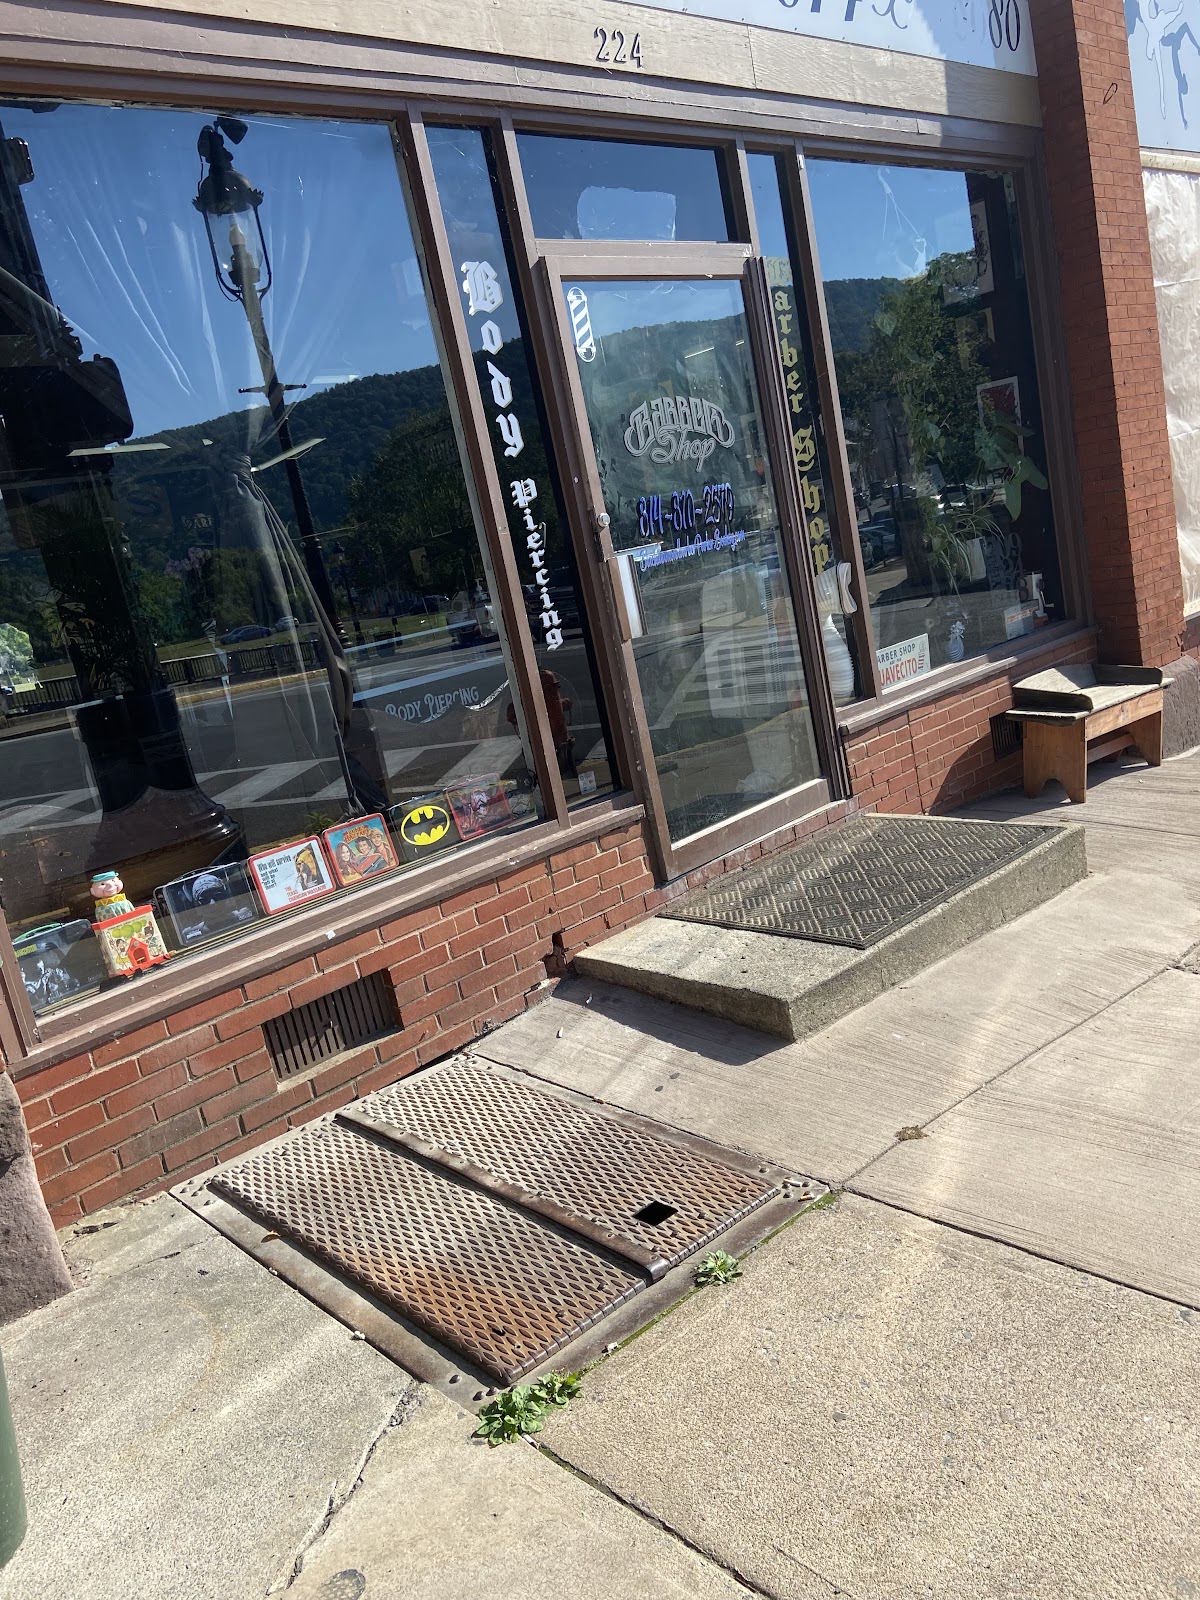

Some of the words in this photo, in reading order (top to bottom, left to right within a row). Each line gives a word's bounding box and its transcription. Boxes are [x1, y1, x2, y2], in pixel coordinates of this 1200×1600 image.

[593, 26, 642, 68] 224
[766, 256, 803, 414] Barber
[793, 424, 829, 576] Shop
[461, 261, 524, 458] Body
[510, 477, 562, 652] Piercing
[878, 650, 898, 663] ARBER
[900, 643, 916, 656] SHOP
[880, 658, 917, 685] UAVECITO
